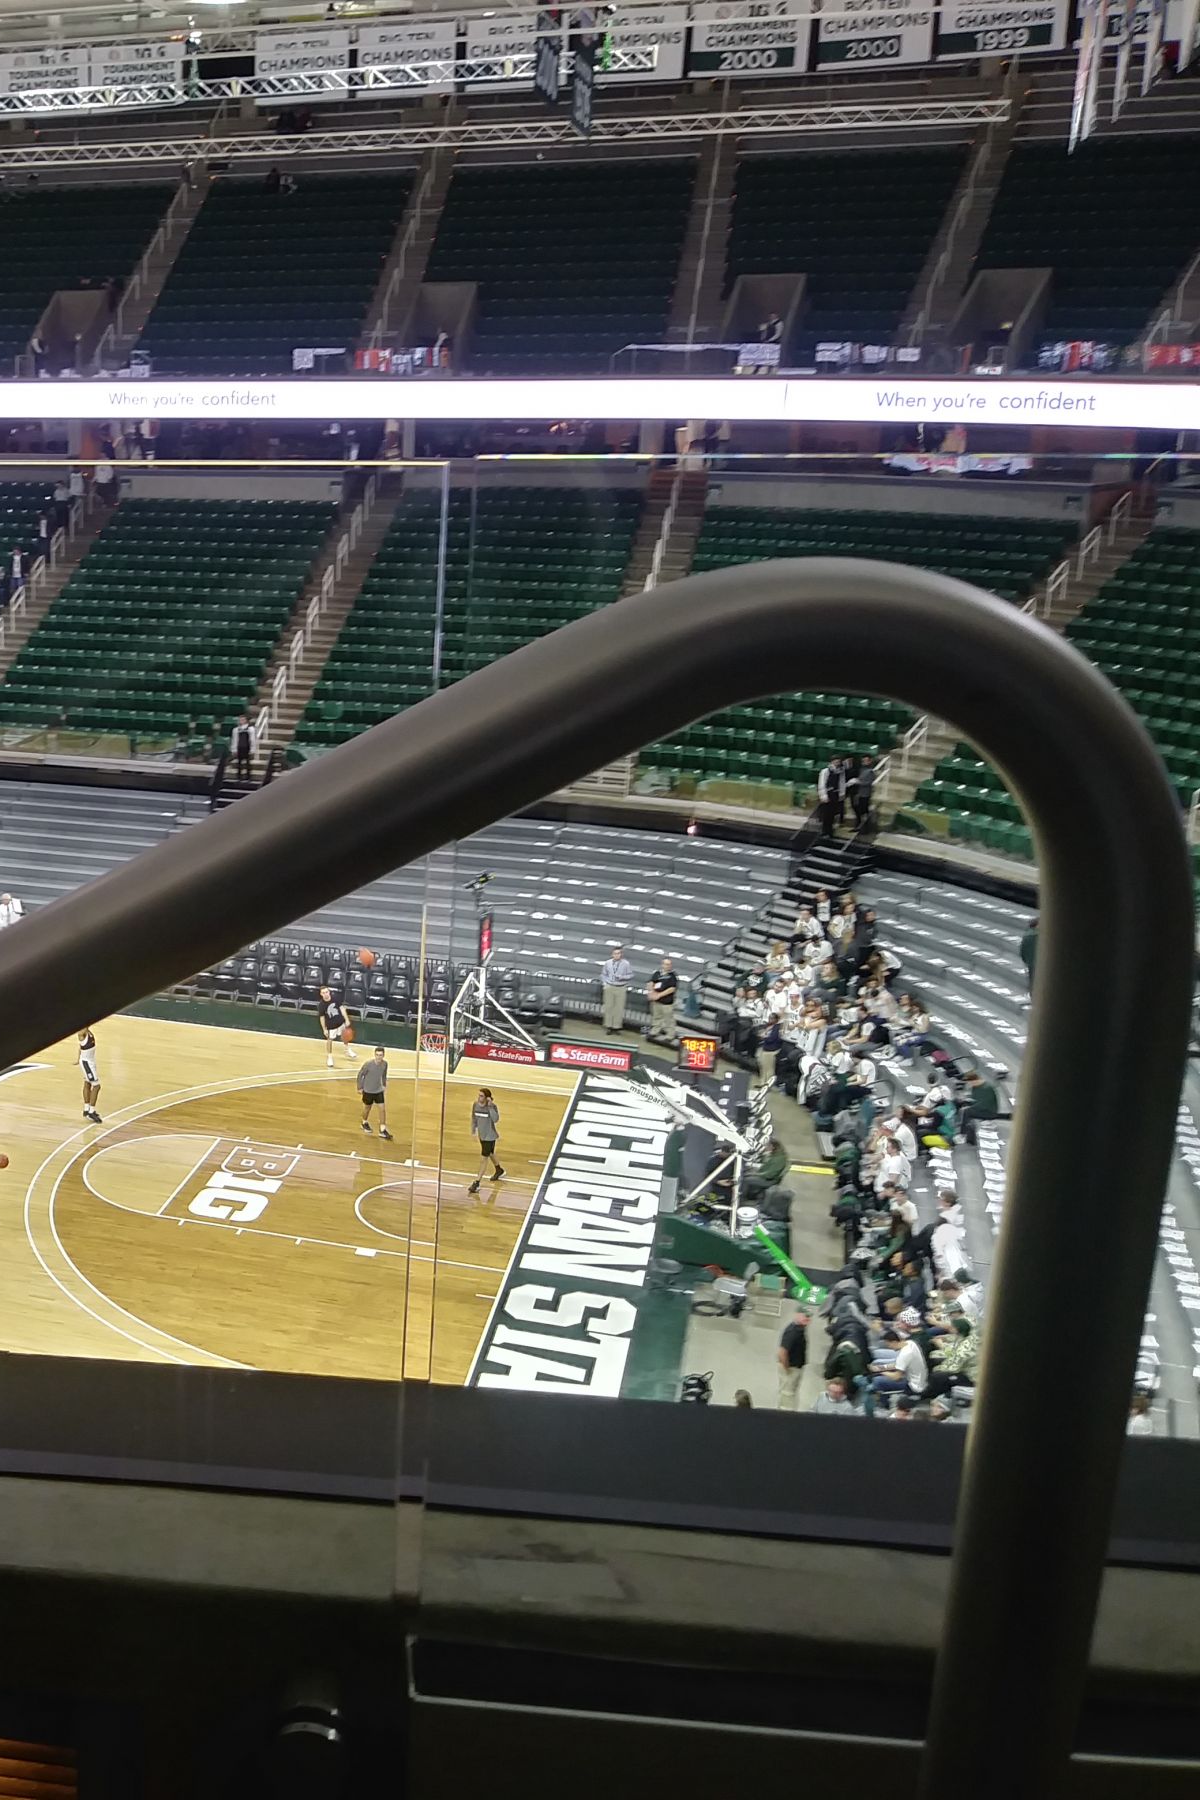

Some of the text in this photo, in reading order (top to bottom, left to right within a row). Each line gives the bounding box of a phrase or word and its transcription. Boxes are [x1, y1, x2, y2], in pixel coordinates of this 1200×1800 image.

[707, 19, 798, 34] TOURNAMENT
[823, 12, 931, 34] CHAMPIONS
[955, 7, 1055, 29] CHAMPIONS
[705, 31, 798, 48] CHAMPIONS
[845, 38, 900, 60] 2000
[973, 28, 1030, 51] 1999
[258, 53, 346, 73] CHAMPIONS
[361, 46, 452, 65] CHAMPIONS
[719, 49, 779, 70] 2000
[9, 66, 79, 81] TOURNAMENT
[102, 60, 176, 74] TOURNAMENT
[102, 71, 177, 86] CHAMPIONS
[108, 390, 277, 409] When you're confident
[876, 390, 1097, 412] When you're confident
[687, 1052, 706, 1066] 30
[519, 1074, 680, 1288] MICHIGAN
[478, 1283, 638, 1398] STA
